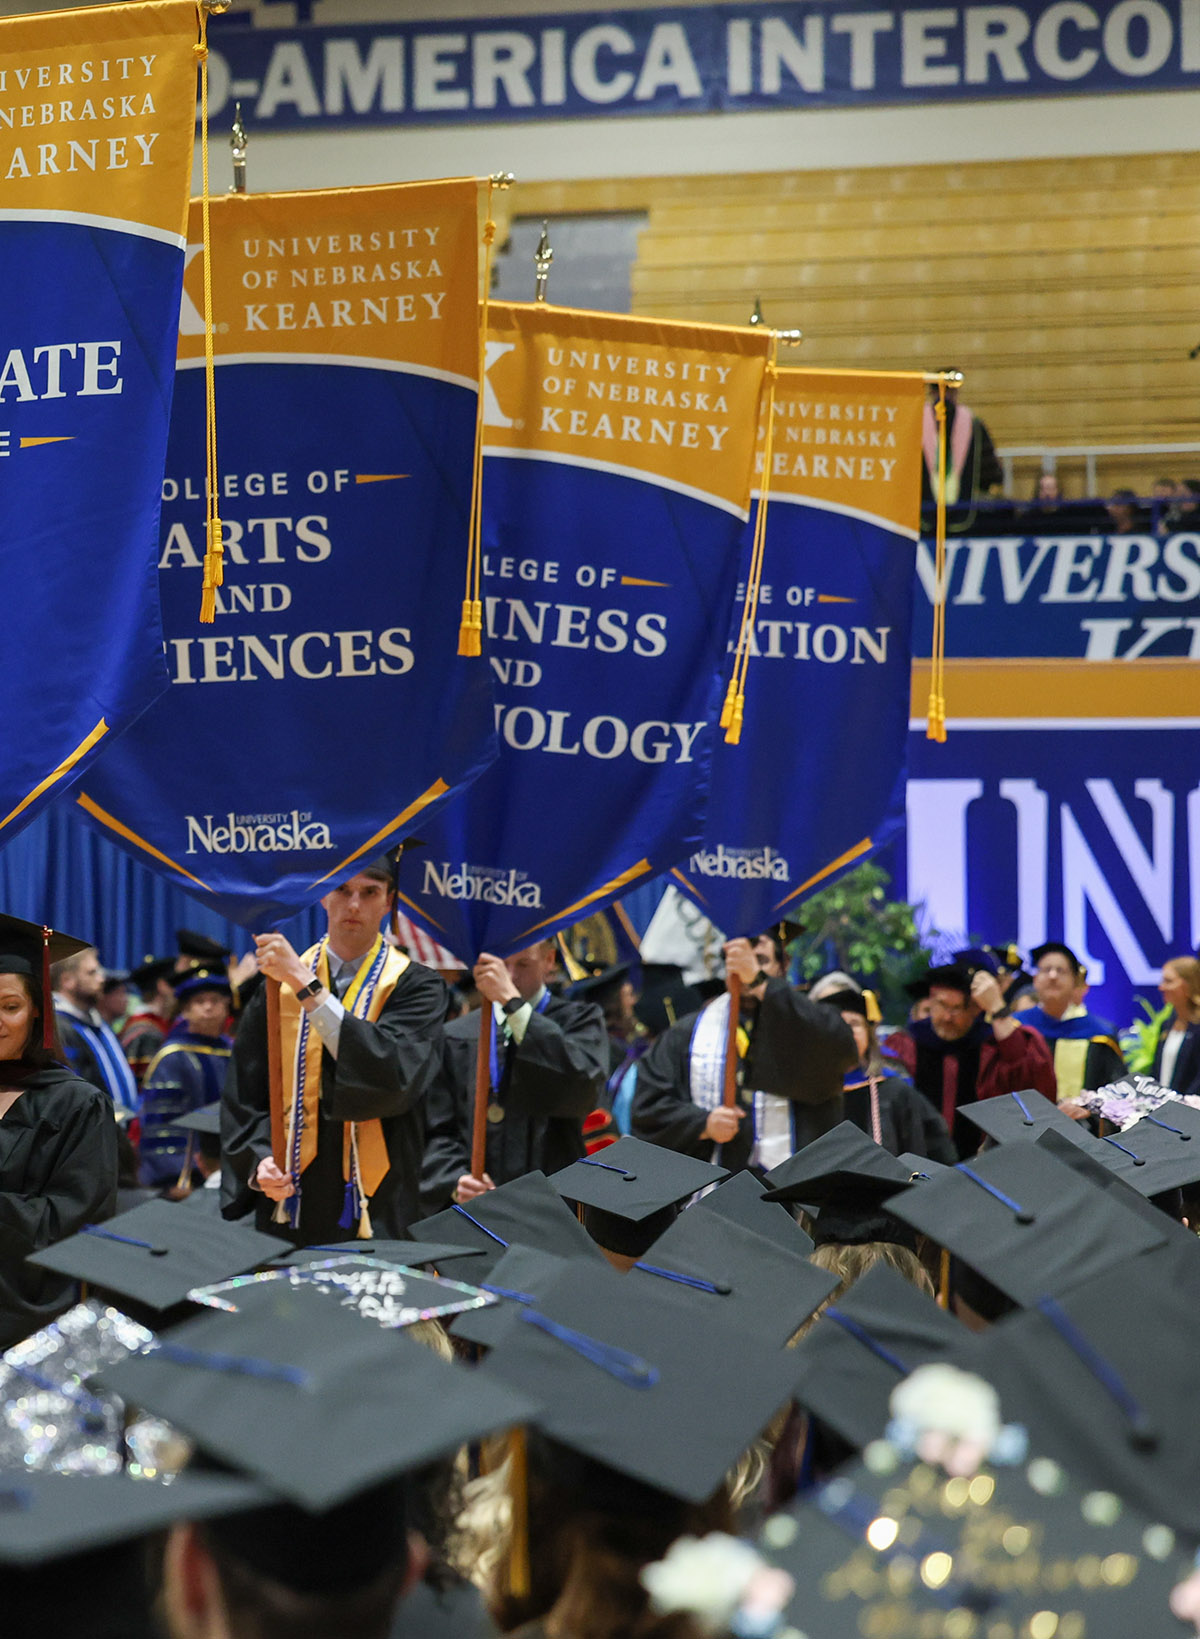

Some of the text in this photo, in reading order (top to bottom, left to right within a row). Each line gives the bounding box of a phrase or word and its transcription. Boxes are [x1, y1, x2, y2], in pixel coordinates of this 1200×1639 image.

[243, 227, 440, 258] UNIVERSITY
[242, 259, 443, 290] OF NEBRASKA
[244, 292, 447, 332] KEARNEY
[547, 347, 731, 384] UNIVERSITY
[543, 376, 729, 413] OF NEBRASKA
[540, 406, 730, 451] KEARNEY
[786, 427, 897, 447] NEBRASKA
[307, 470, 349, 494] OF
[575, 565, 617, 589] OF
[786, 585, 815, 607] OF
[163, 627, 415, 685] IENCES
[185, 810, 334, 854] Nebraska
[689, 844, 789, 882] Nebraska
[421, 860, 542, 909] Nebraska
